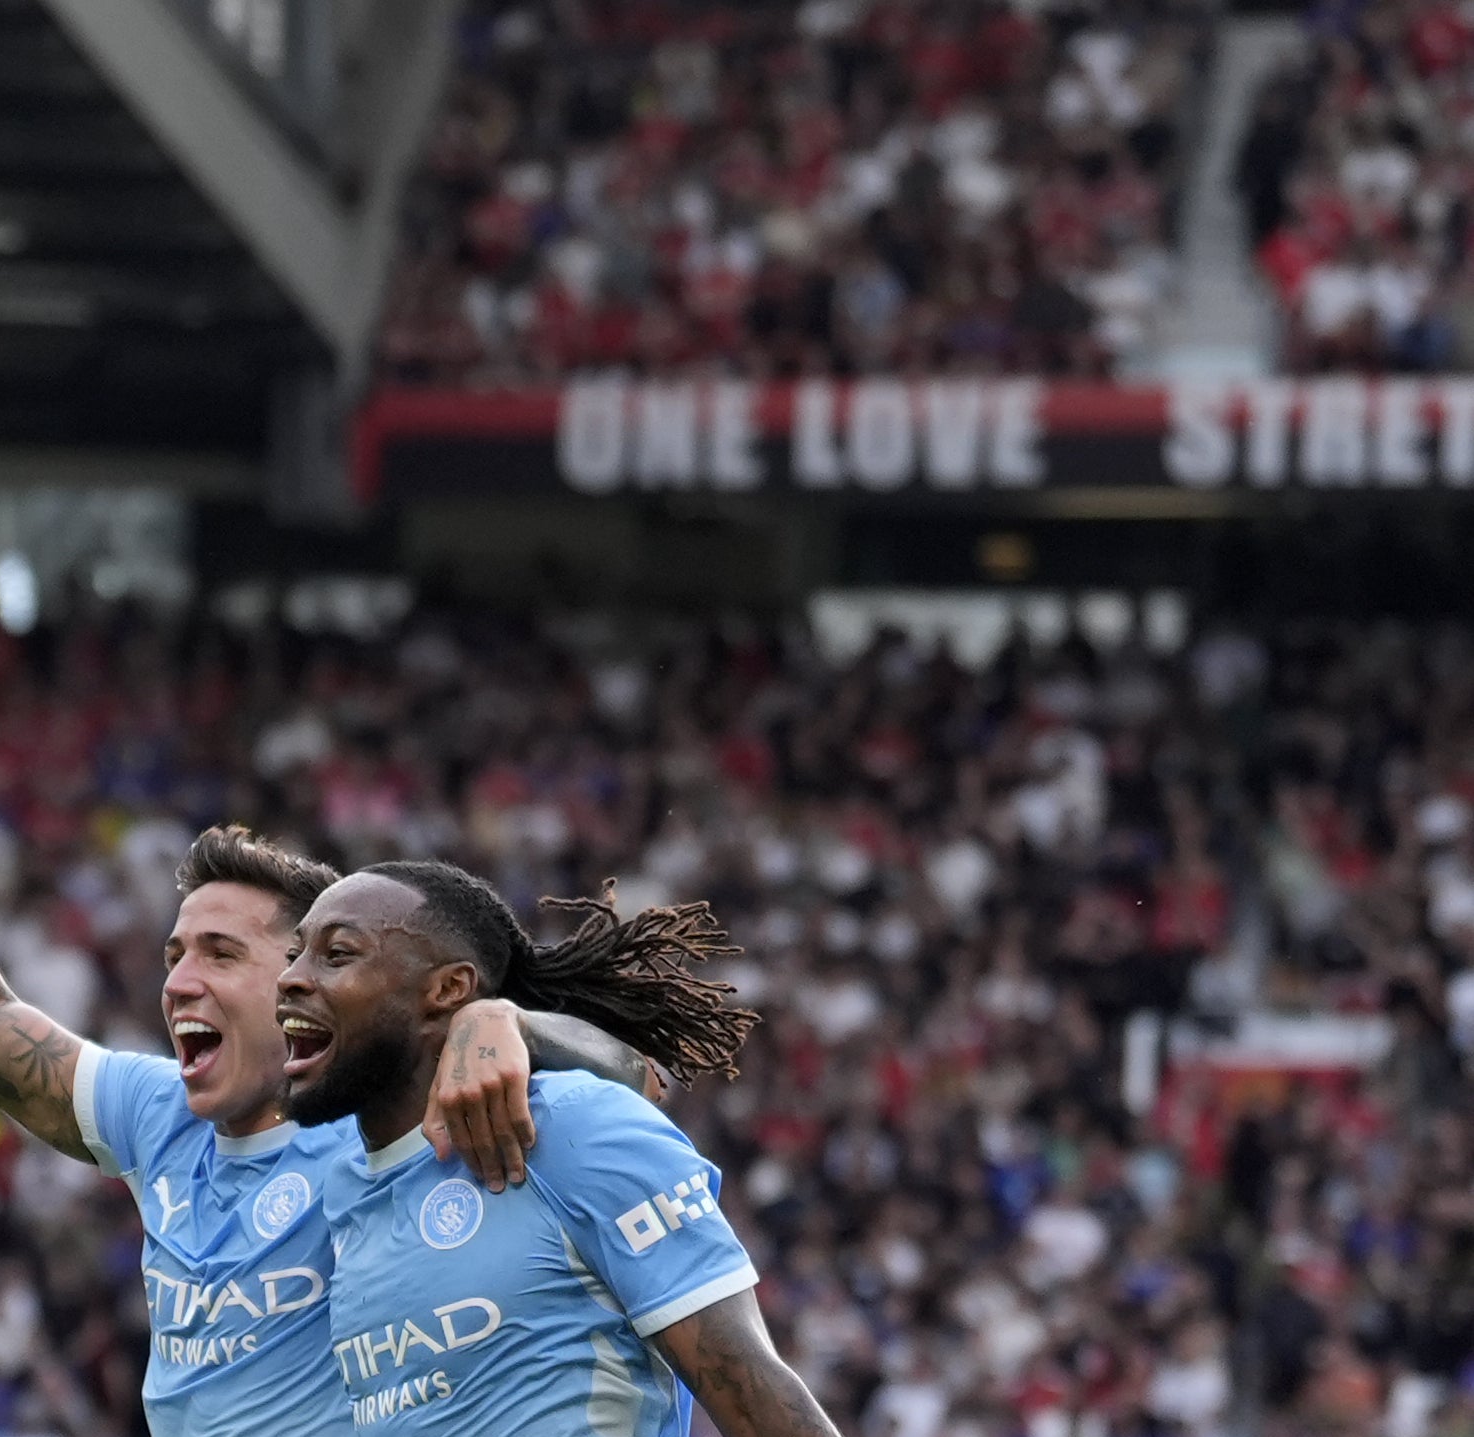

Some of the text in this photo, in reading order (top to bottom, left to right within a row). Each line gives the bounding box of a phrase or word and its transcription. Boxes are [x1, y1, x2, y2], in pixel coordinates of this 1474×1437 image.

[559, 370, 762, 494] ONE
[792, 374, 1044, 490] LOVE
[332, 1297, 501, 1384] TIHAD
[353, 1371, 452, 1431] AIRWAYS
